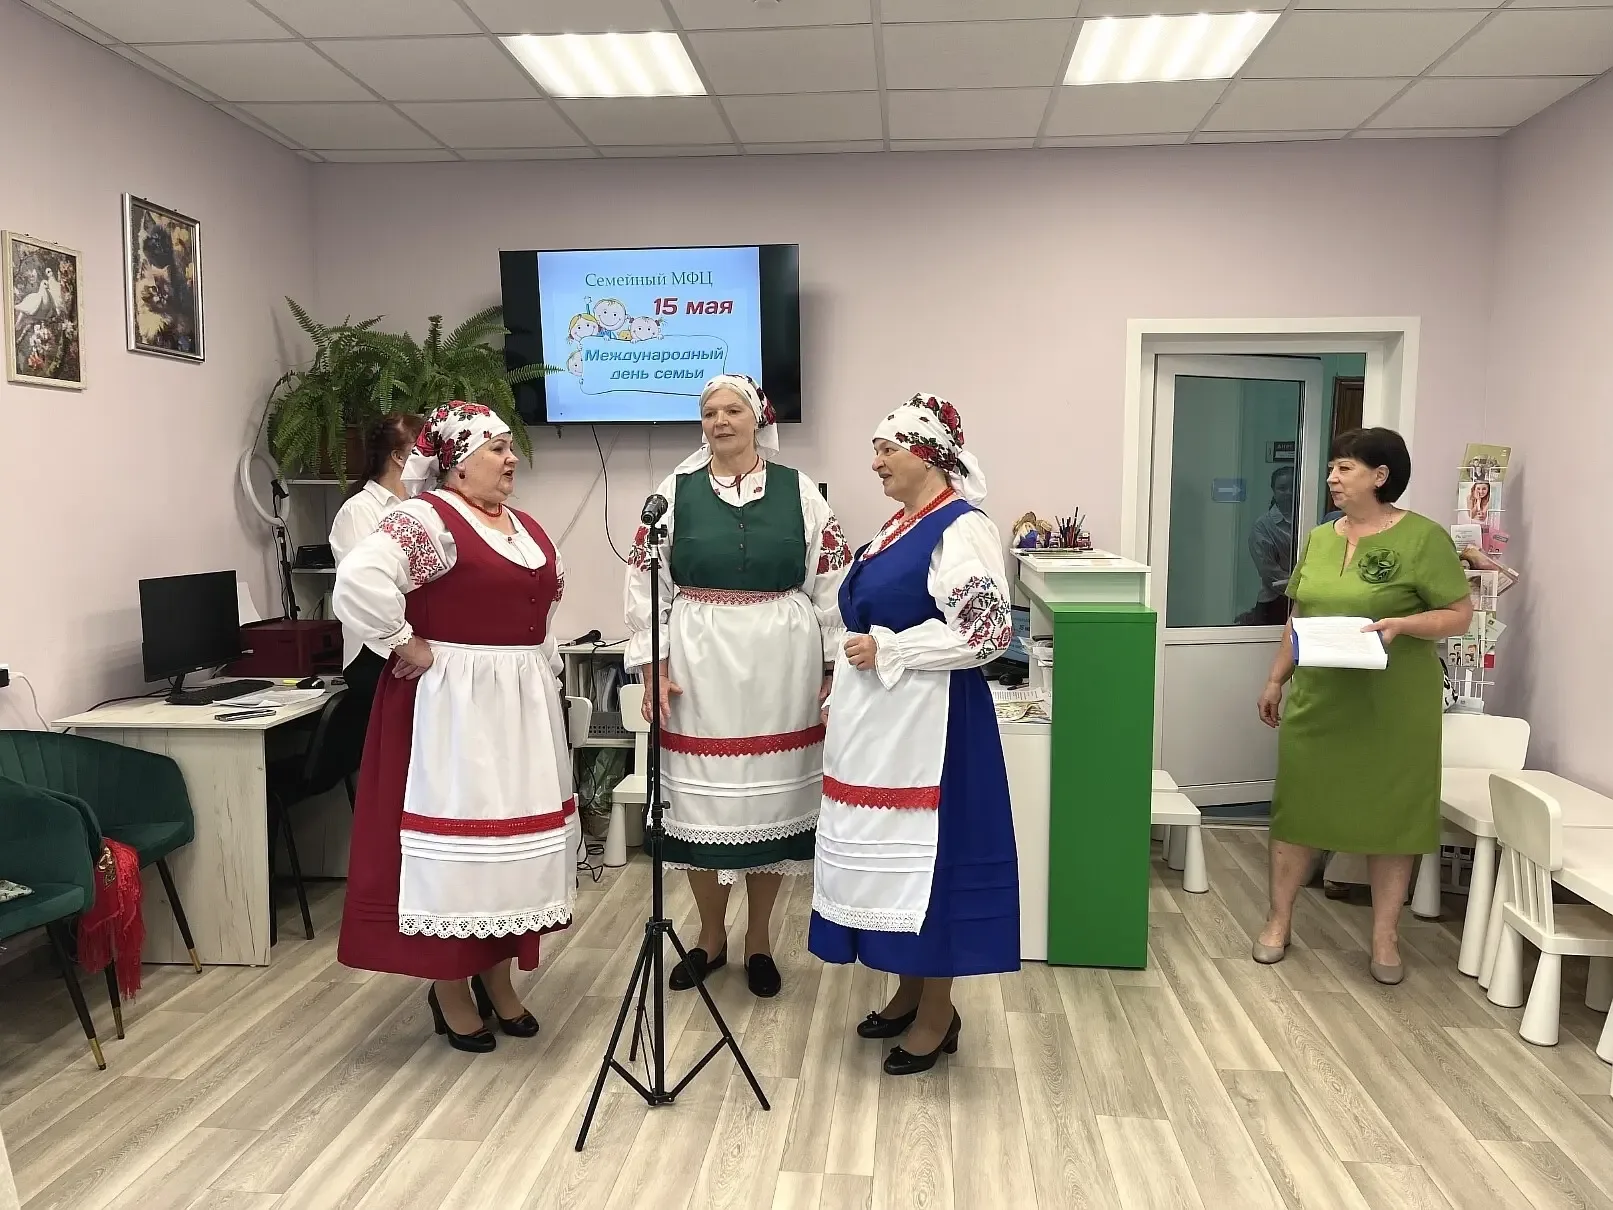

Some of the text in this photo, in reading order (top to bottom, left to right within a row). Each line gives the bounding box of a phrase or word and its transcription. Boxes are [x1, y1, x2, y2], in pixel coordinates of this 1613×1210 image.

[585, 271, 713, 288] Семейный МФЦ
[653, 297, 734, 315] 15 мая
[585, 346, 724, 363] Международный
[610, 369, 704, 380] день семьи
